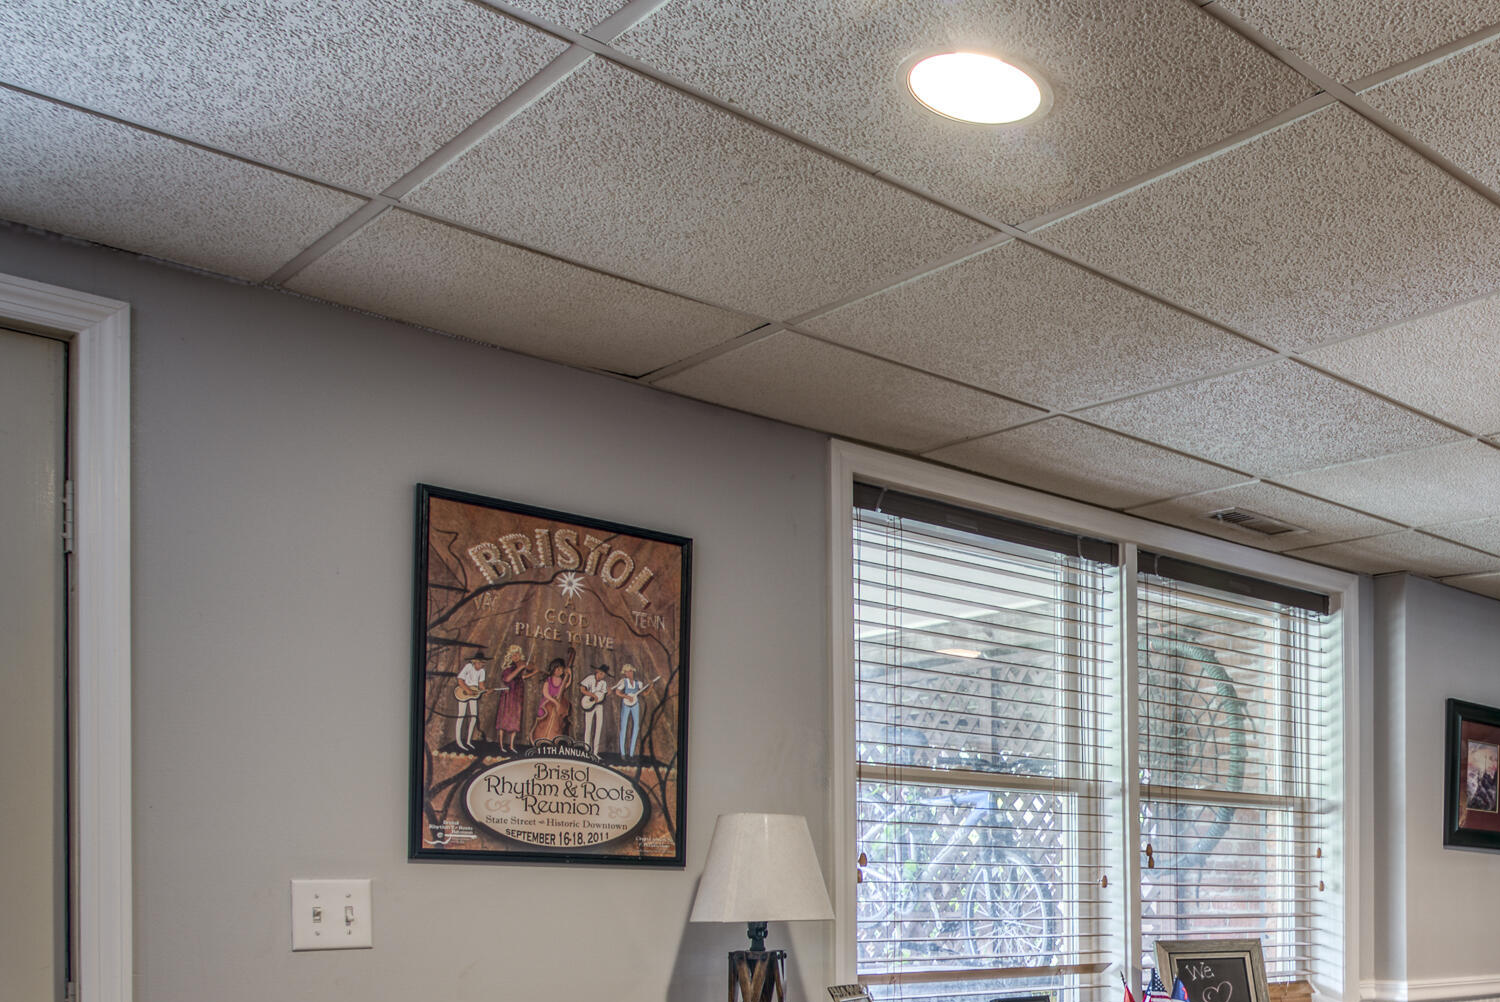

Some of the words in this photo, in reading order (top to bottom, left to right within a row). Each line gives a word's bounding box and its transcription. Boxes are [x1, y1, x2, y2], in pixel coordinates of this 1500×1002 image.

[468, 529, 655, 608] BRISTOL
[544, 608, 590, 628] GOOD
[632, 610, 665, 630] TENN
[515, 622, 562, 643] PLACE
[585, 633, 614, 651] LIVE
[537, 746, 557, 755] 11TH
[558, 745, 591, 759] ANNUAL
[534, 762, 590, 782] Bristol
[484, 774, 559, 800] Rhythm
[563, 781, 579, 798] &
[581, 781, 635, 801] Roots
[522, 795, 600, 816] Reunion
[486, 816, 508, 825] State
[511, 816, 536, 826] Street
[546, 818, 580, 828] Historic
[583, 820, 628, 831] Downtown
[505, 828, 556, 845] SEPTEMBER
[587, 832, 609, 844] 2011
[1185, 962, 1214, 981] We
